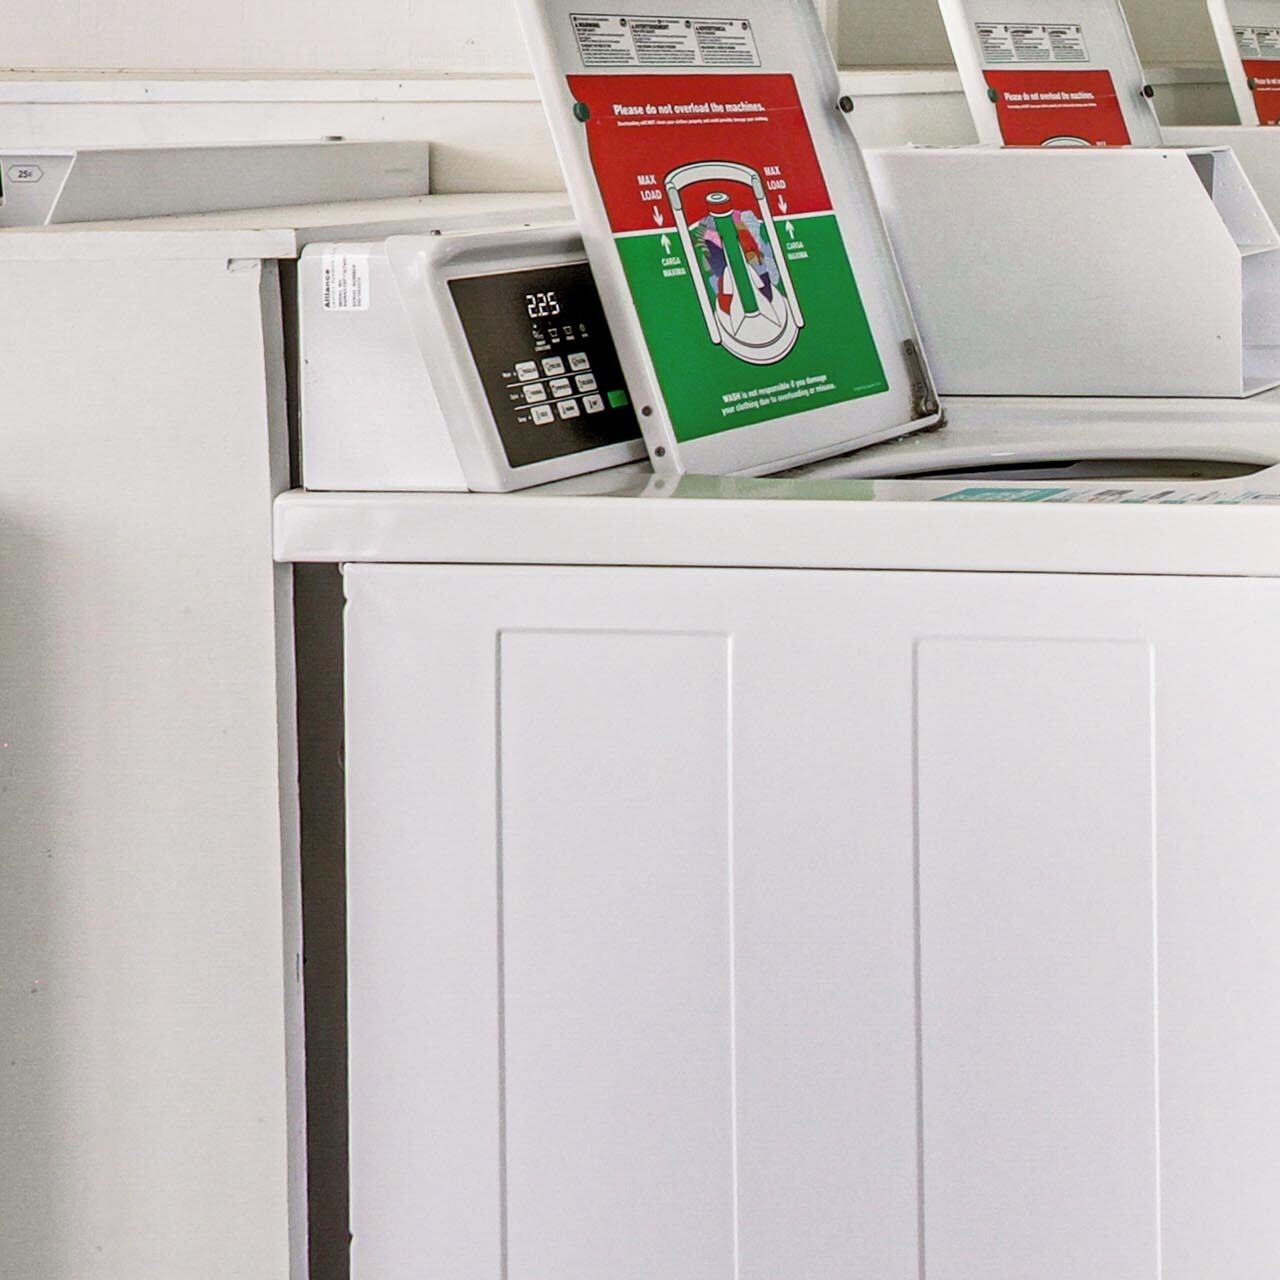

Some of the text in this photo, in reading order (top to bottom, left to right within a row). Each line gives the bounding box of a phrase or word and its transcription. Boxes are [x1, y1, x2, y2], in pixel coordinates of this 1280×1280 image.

[613, 101, 766, 116] Please do not overload the machines.
[764, 166, 781, 176] MAX
[637, 175, 657, 185] MAX
[766, 180, 786, 190] LOAD
[640, 190, 662, 201] LOAD
[661, 256, 681, 266] CARGA
[722, 392, 741, 403] WASH
[741, 391, 748, 399] is
[748, 389, 758, 397] not
[758, 382, 790, 395] responsible
[795, 379, 806, 388] you
[806, 374, 827, 385] damage
[721, 406, 735, 416] your
[735, 400, 760, 411] clothing
[759, 397, 770, 406] due
[770, 395, 777, 403] to
